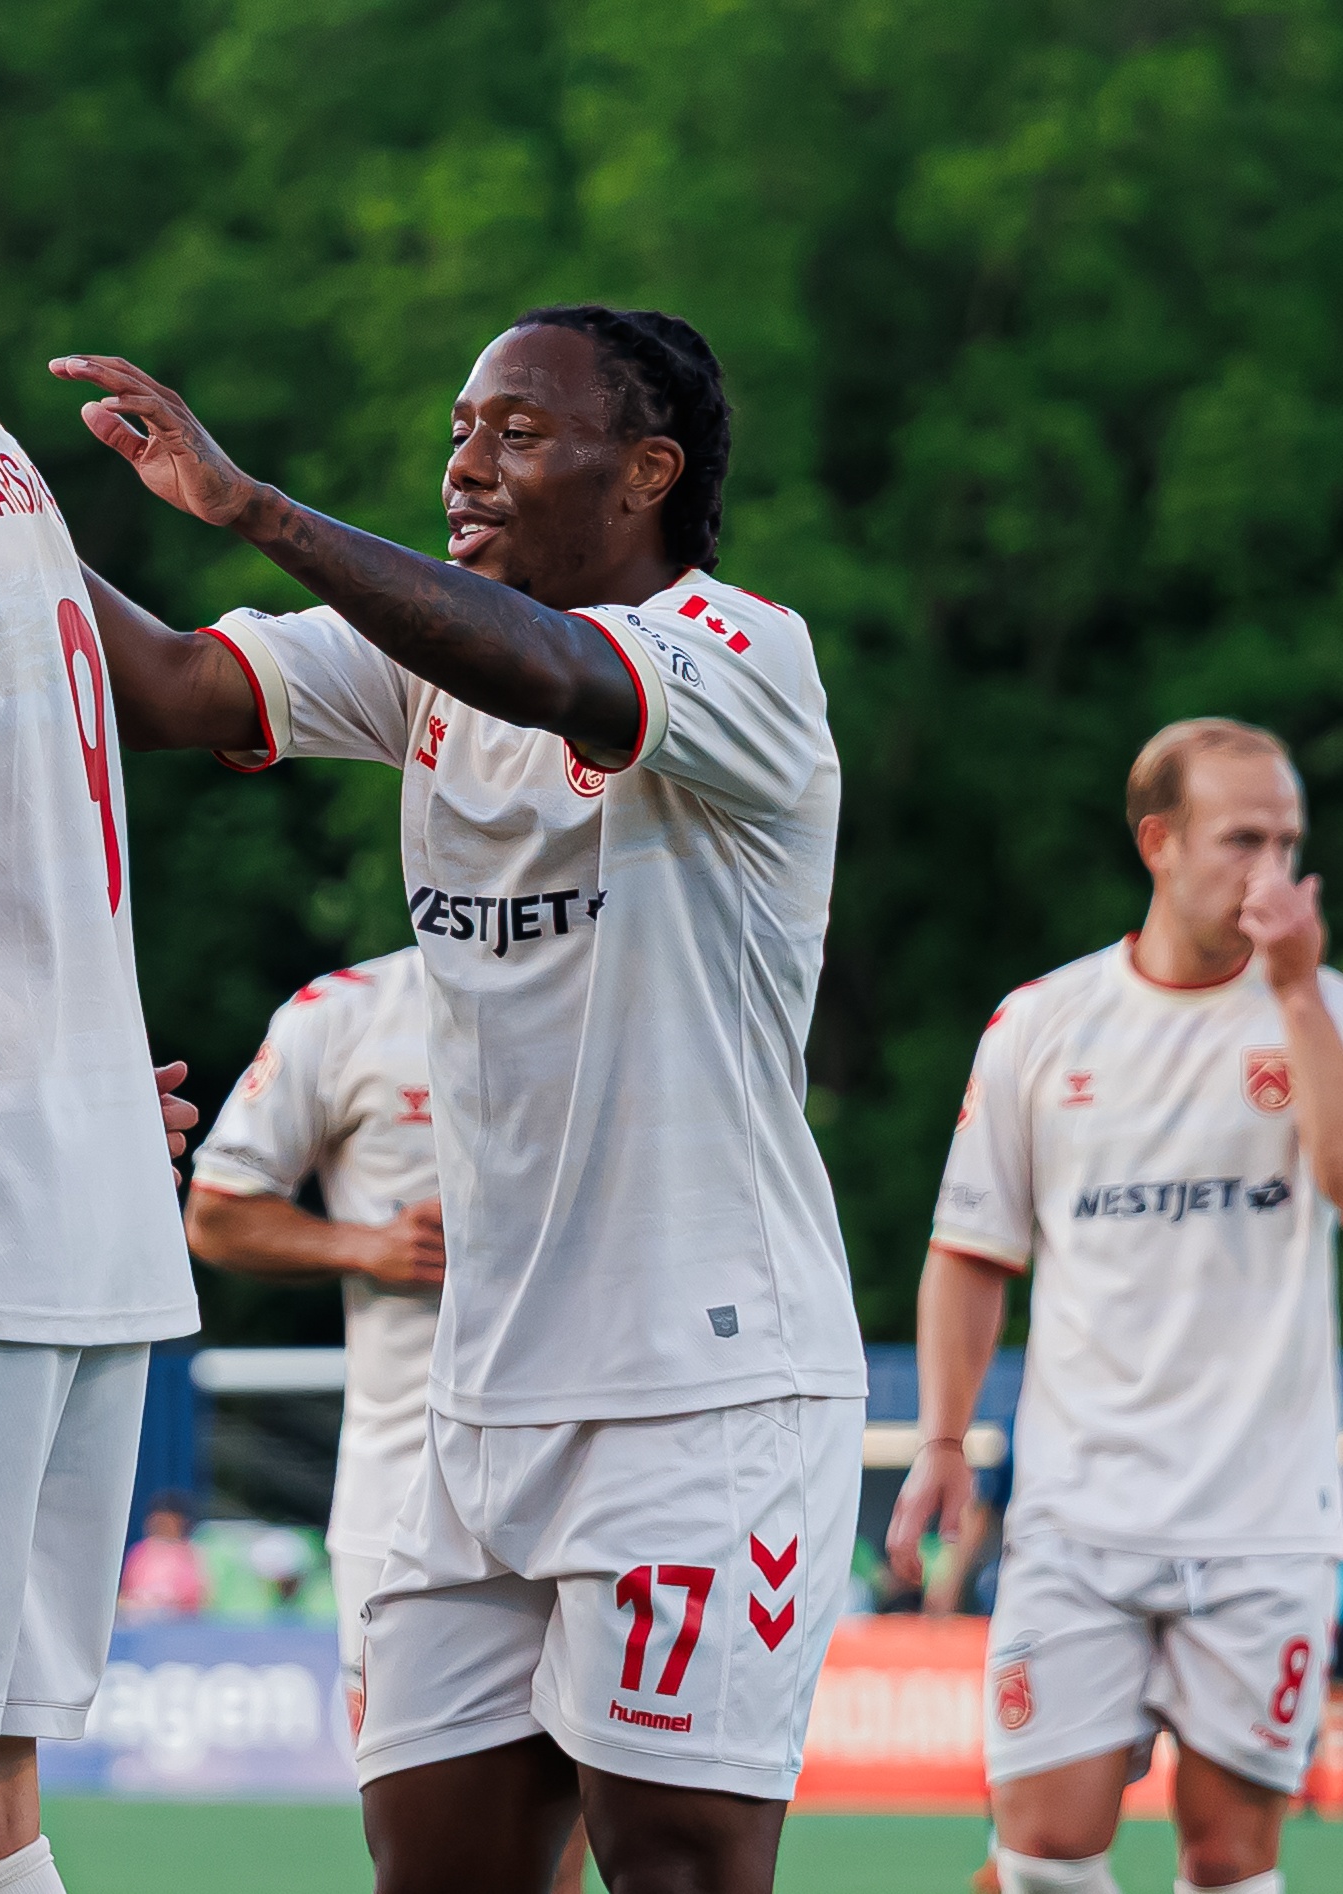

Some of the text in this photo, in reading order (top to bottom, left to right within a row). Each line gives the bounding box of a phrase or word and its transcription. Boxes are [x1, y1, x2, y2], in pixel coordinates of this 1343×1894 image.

[57, 598, 122, 917] 9
[615, 1564, 716, 1697] 17
[1269, 1634, 1311, 1724] 8
[609, 1699, 692, 1733] hummel
